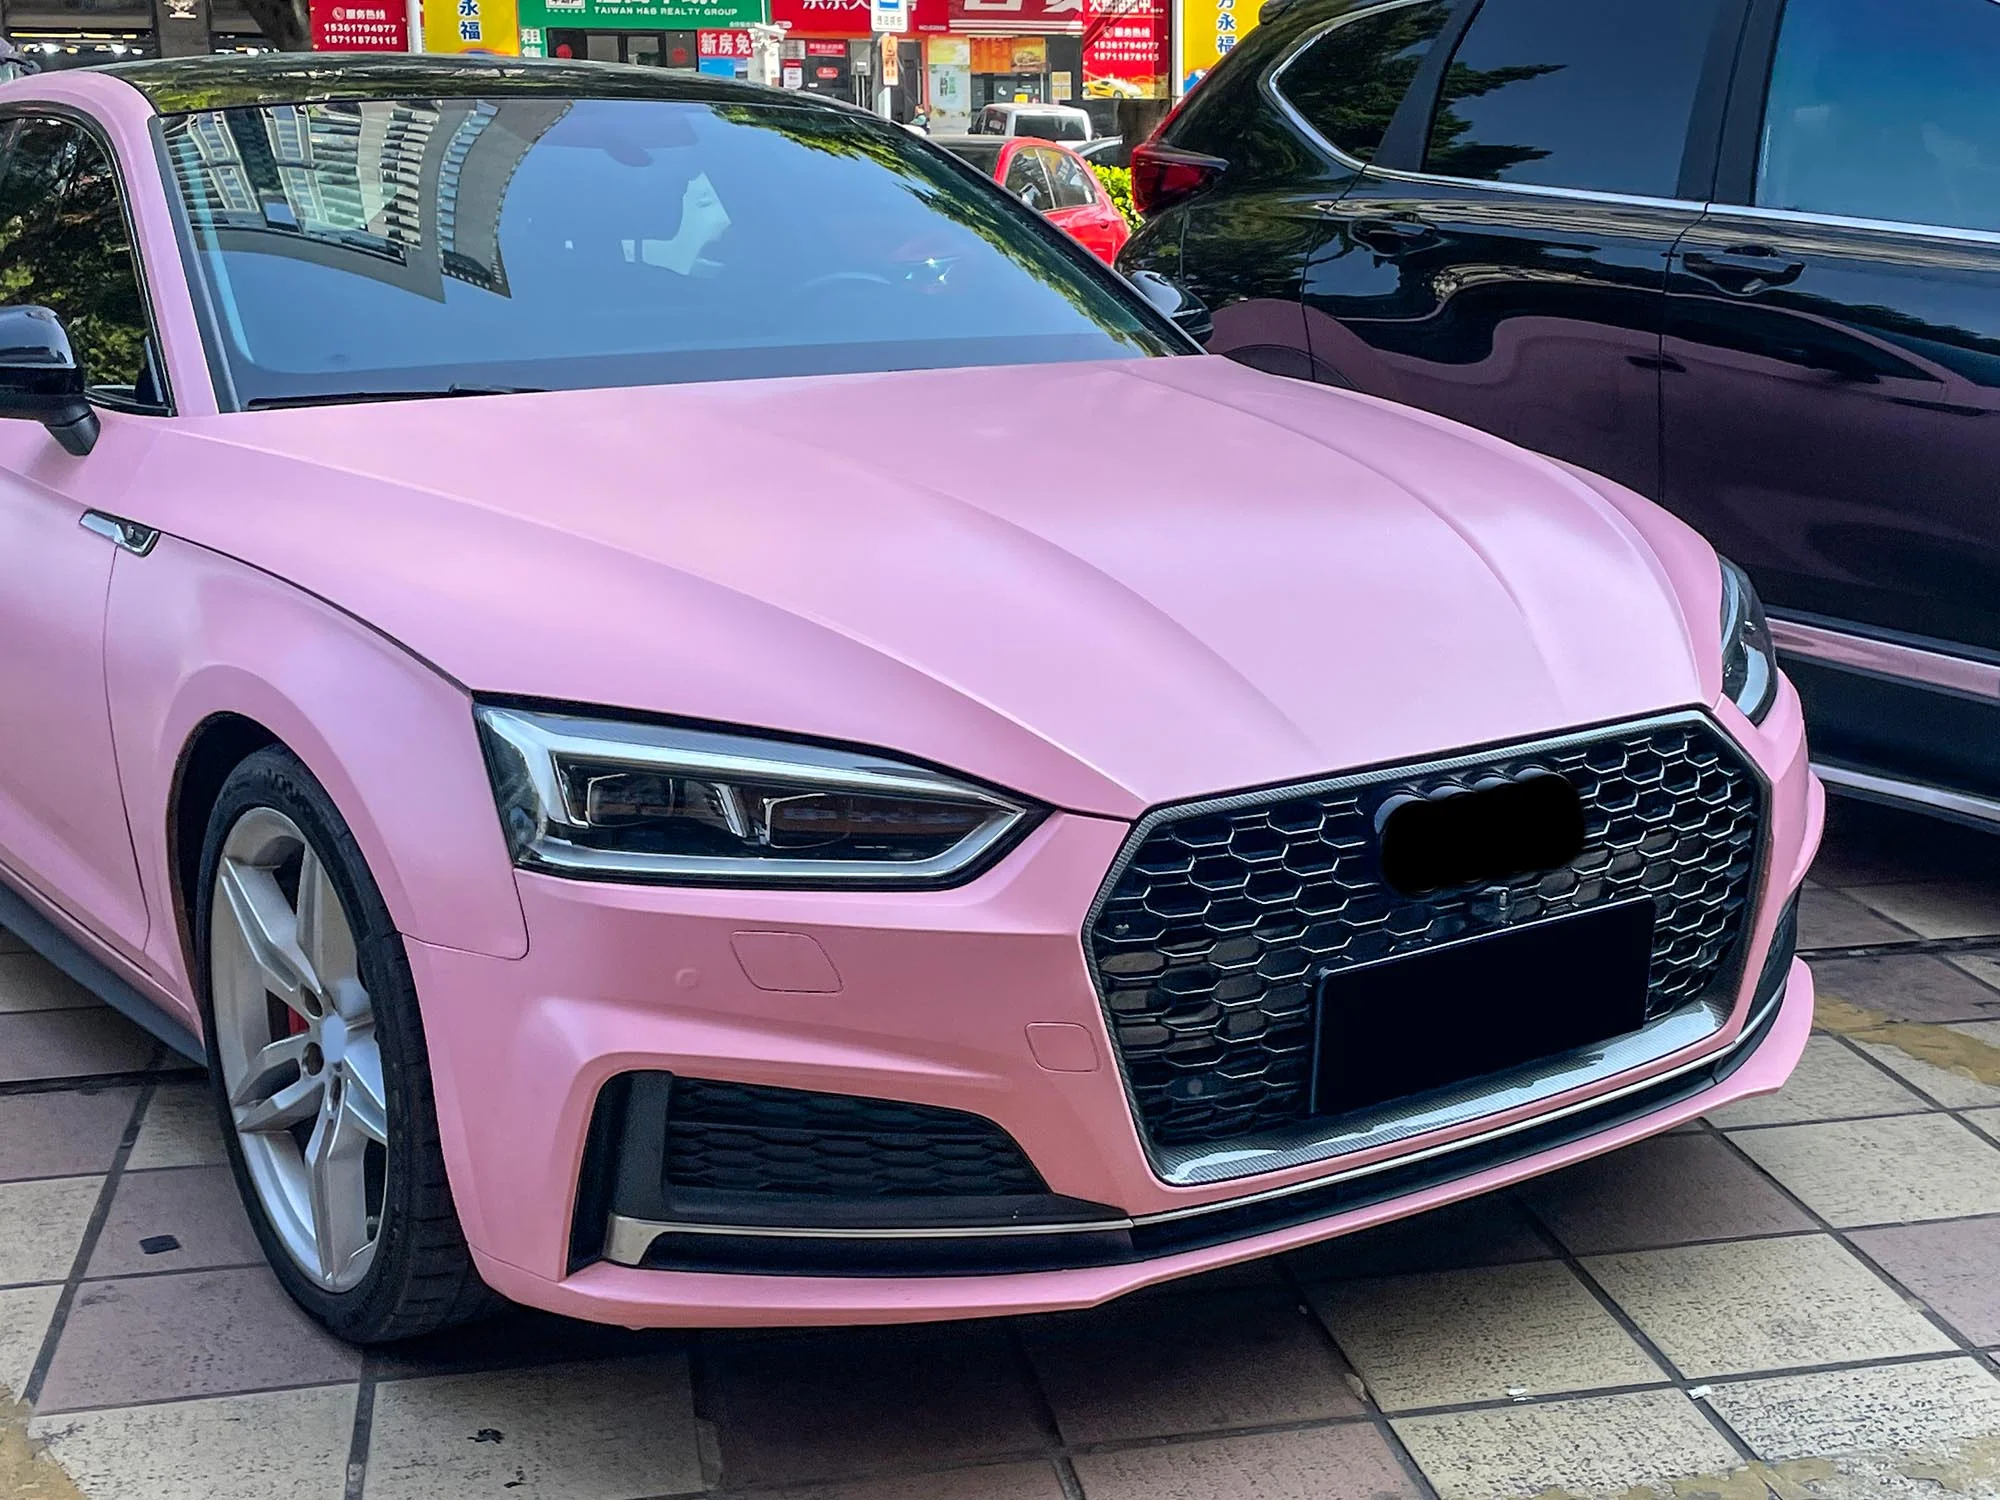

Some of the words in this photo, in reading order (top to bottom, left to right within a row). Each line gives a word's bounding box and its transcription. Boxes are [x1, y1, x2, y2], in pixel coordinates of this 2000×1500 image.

[346, 9, 387, 21] 服务热线
[594, 6, 633, 15] TAIWAN
[636, 7, 657, 15] H&B
[660, 8, 700, 16] REALTY
[704, 8, 738, 16] GROUP
[323, 23, 397, 33] 15361794977
[700, 32, 752, 55] 新房免
